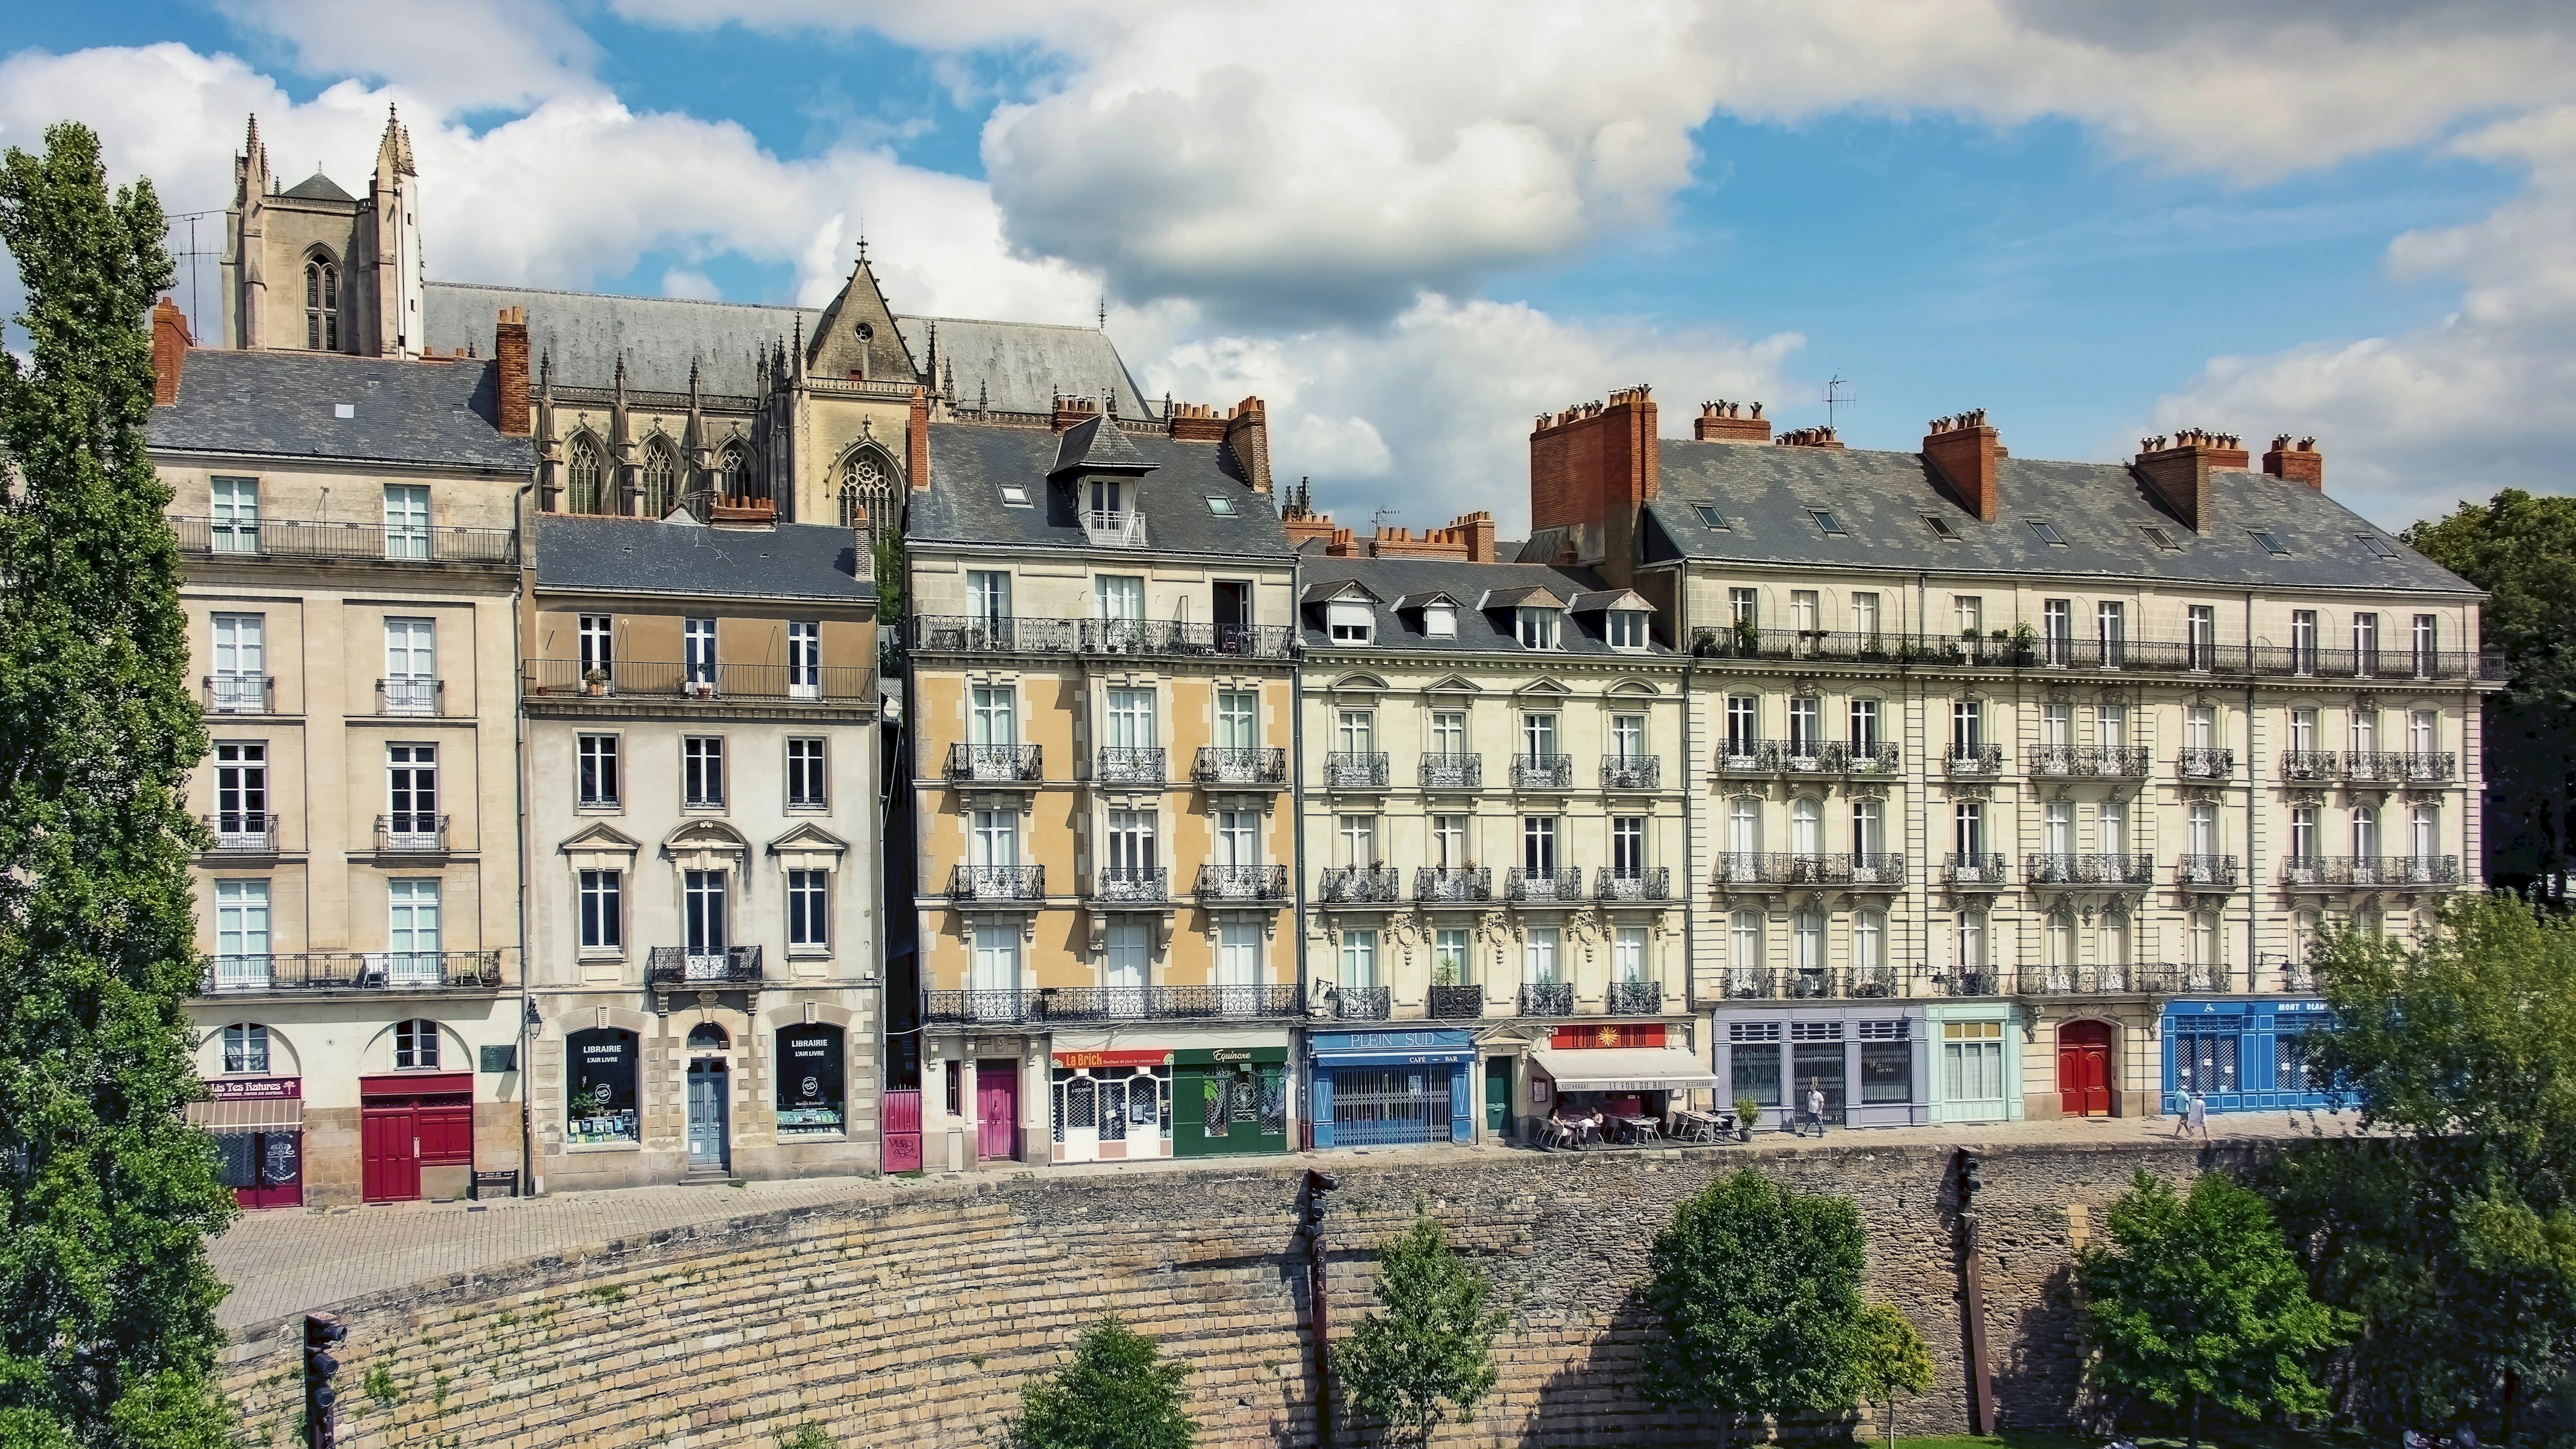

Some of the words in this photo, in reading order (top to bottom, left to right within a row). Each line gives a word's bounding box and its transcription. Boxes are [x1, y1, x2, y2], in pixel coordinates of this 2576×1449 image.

[2277, 1003, 2300, 1011] MONT
[1350, 1034, 1392, 1046] PLEIN
[1405, 1032, 1434, 1045] SUD
[1572, 1027, 1579, 1047] LE
[1582, 1026, 1596, 1047] FOU
[1621, 1026, 1631, 1046] DU
[1633, 1025, 1646, 1046] ROI
[792, 1039, 828, 1047] LIBRAIRIE
[583, 1045, 622, 1053] LIBRAIRIE
[1066, 1054, 1076, 1066] La
[1077, 1053, 1102, 1066] Brick
[1213, 1049, 1251, 1063] Equinoxe
[211, 1083, 225, 1092] Lis
[226, 1082, 244, 1092] Tes
[245, 1081, 281, 1091] Ratures
[1609, 1082, 1617, 1090] LE
[1621, 1082, 1635, 1090] FOU
[1639, 1081, 1648, 1089] DU
[1653, 1081, 1666, 1089] ROI
